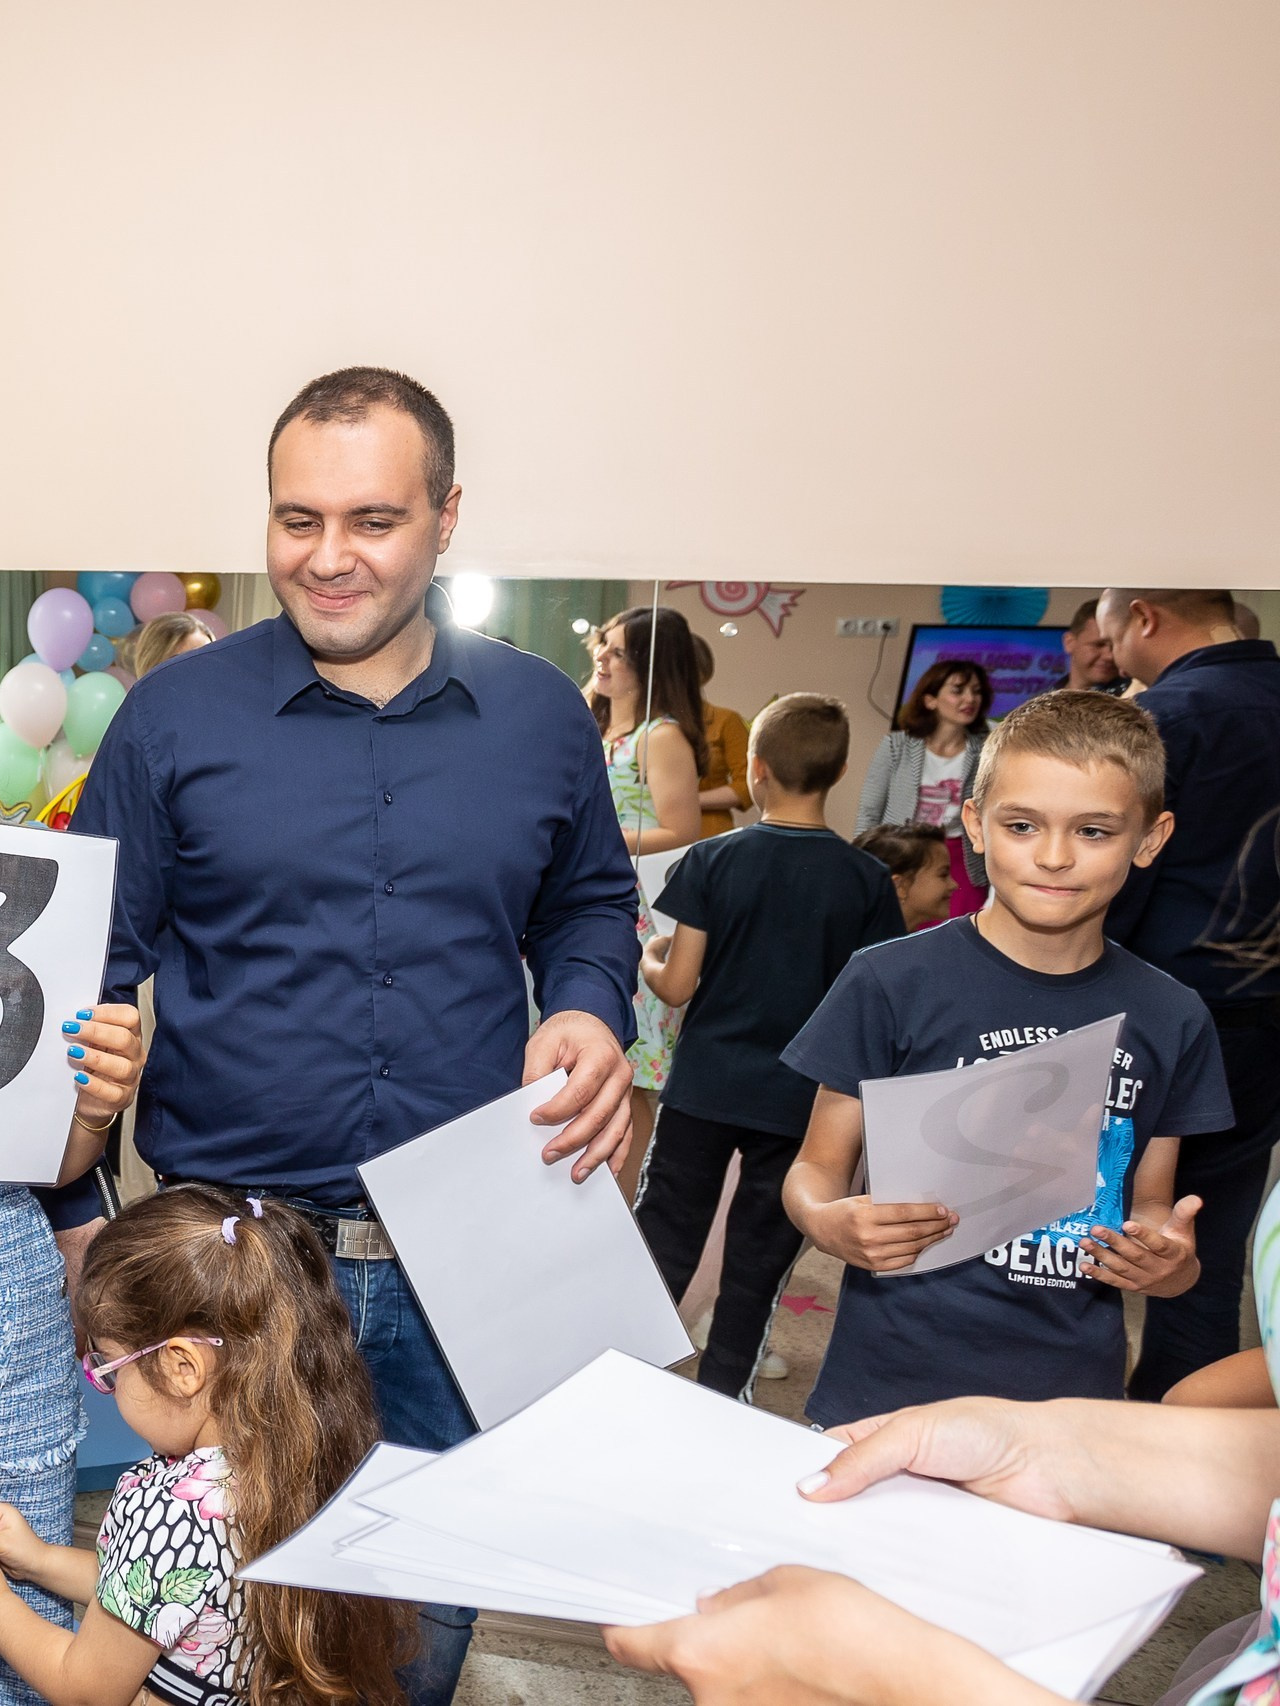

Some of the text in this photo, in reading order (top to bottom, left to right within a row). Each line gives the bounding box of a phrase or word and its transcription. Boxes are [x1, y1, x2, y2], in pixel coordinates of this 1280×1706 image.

[978, 1026, 1059, 1051] ENDLESS
[1049, 1220, 1089, 1236] BLAZE
[1007, 1272, 1077, 1289] LIMITED EDITION
